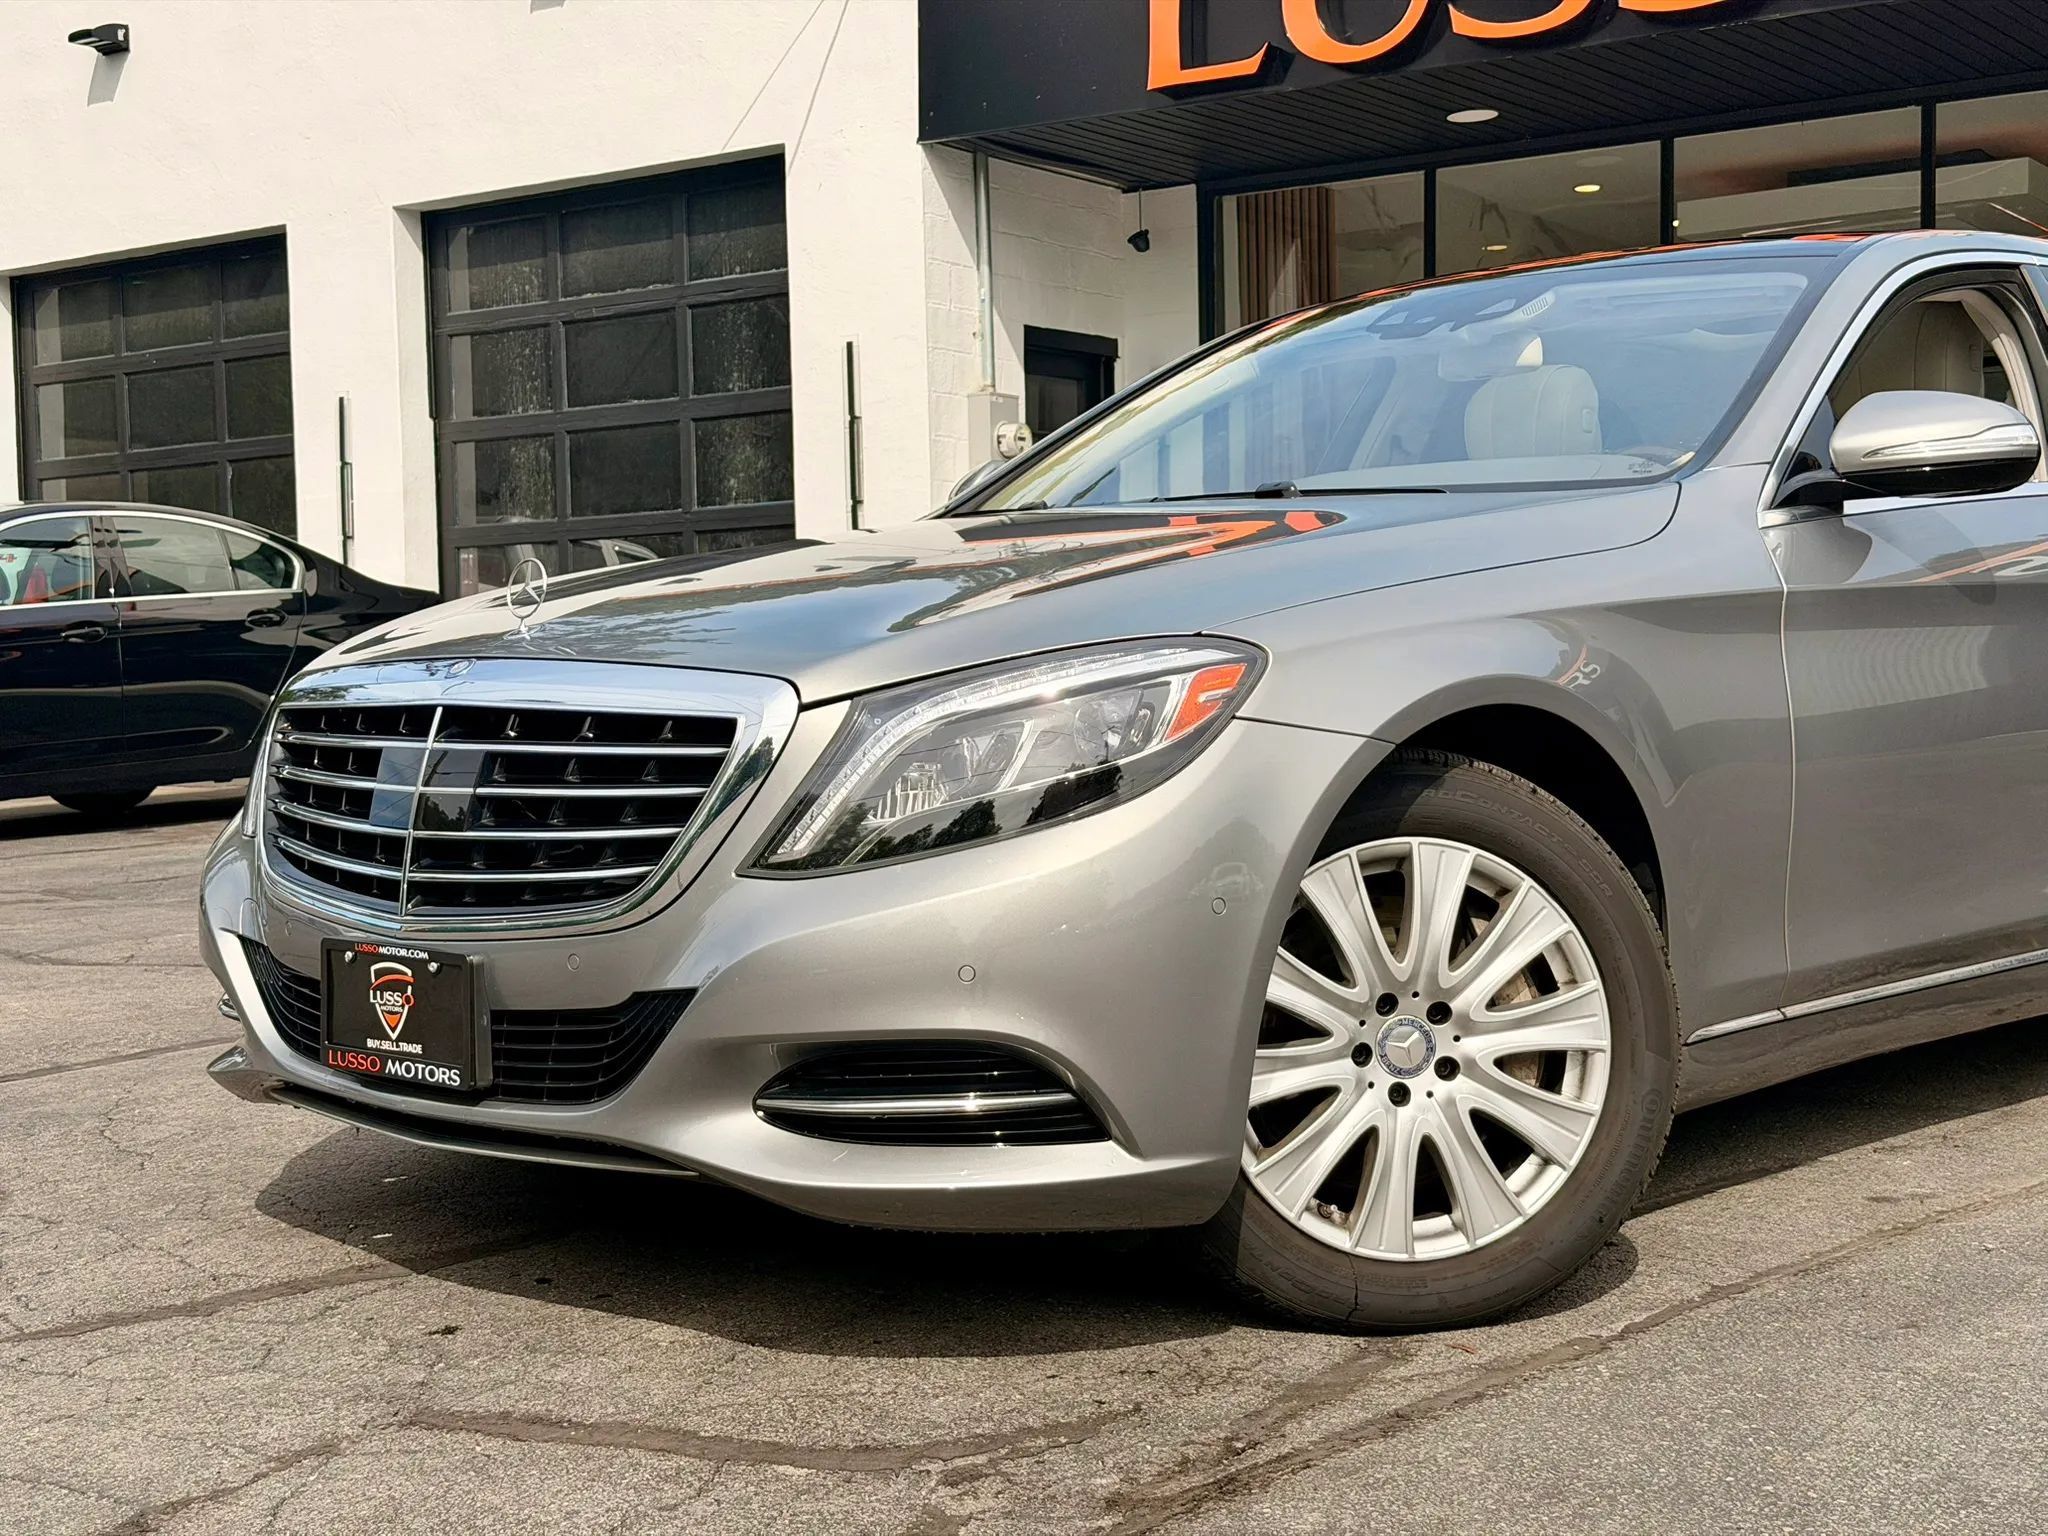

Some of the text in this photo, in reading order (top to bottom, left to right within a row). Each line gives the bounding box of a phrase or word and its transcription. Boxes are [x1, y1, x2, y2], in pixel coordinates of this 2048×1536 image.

[355, 943, 429, 959] LUSSOMOTOR.COM
[369, 989, 415, 1007] LUSSO
[380, 1005, 404, 1013] MOTORS
[328, 1050, 461, 1086] LUSSO MOTORS
